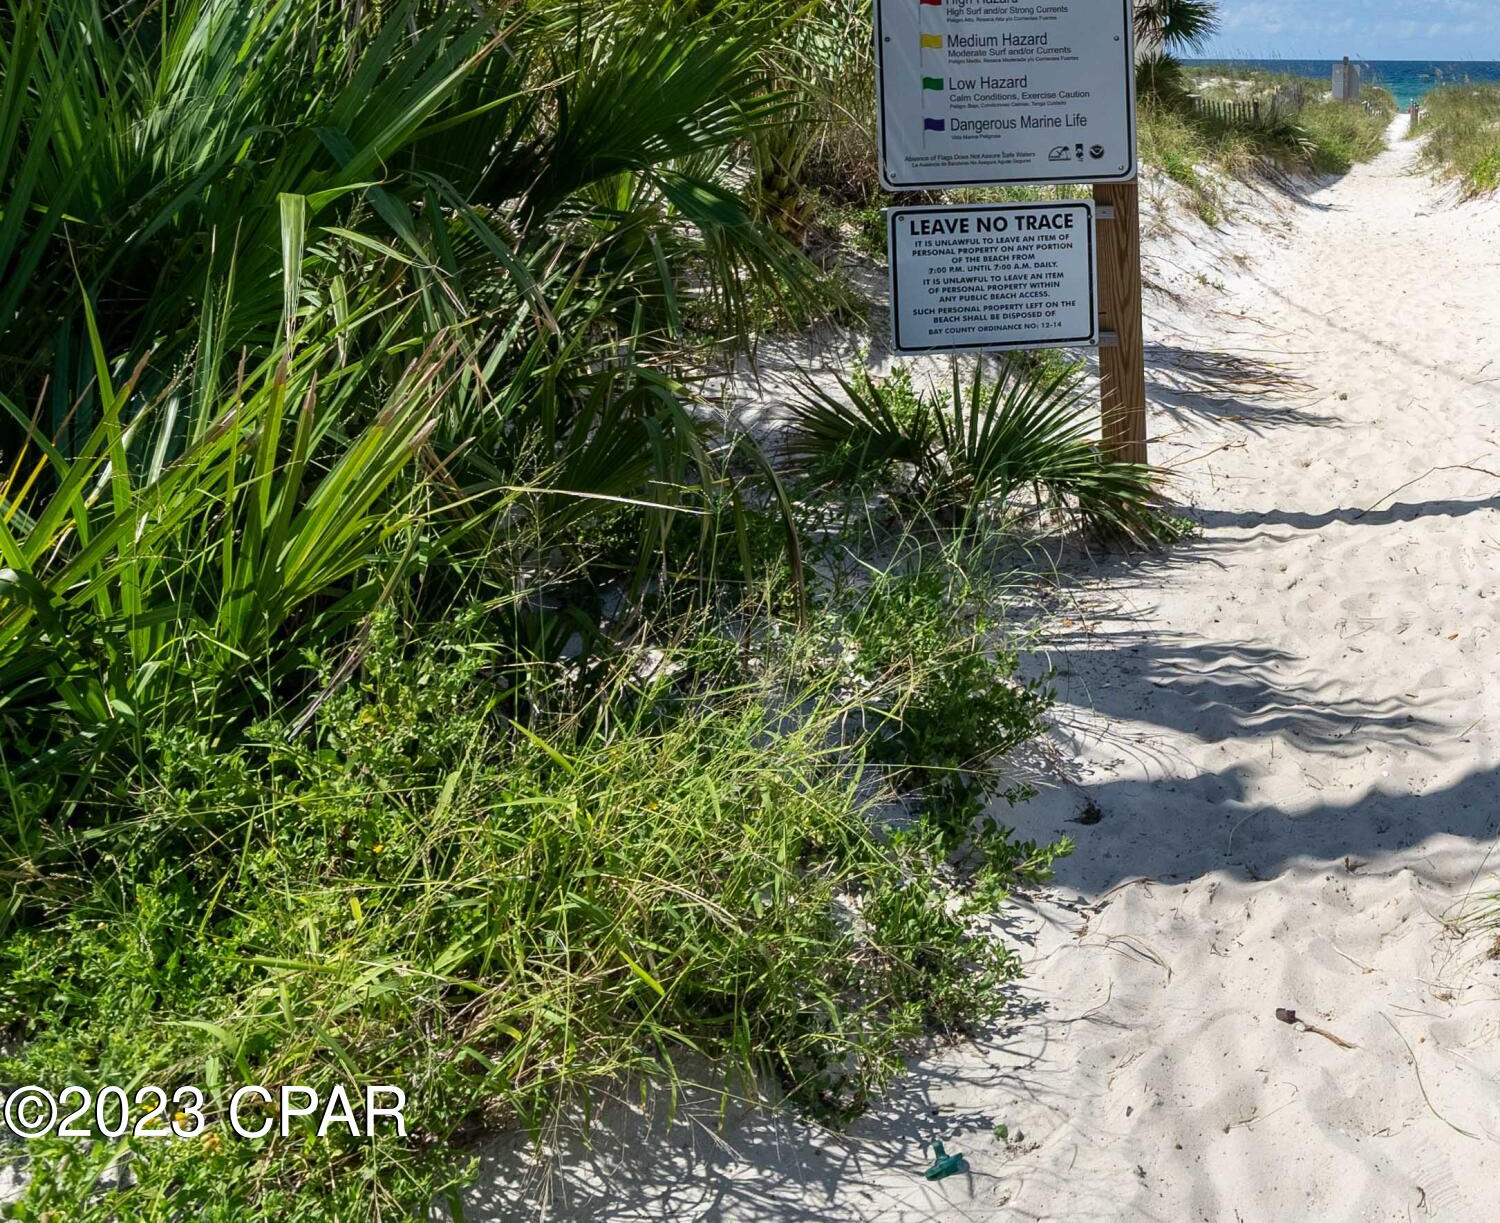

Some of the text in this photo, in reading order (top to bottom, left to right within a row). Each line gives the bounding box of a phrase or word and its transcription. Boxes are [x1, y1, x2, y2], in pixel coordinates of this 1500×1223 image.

[946, 5, 1069, 16] High Surf and/or Strong Currents
[947, 32, 1048, 48] Medium Hazard
[948, 46, 1072, 57] Moderate Surf and/or Currents
[949, 75, 1028, 91] Low Hazard
[949, 90, 1090, 102] Calm Conditions, Exercise Caution
[950, 114, 1088, 133] Dangerous Marine Life
[910, 213, 1074, 236] LEAVE NO TRACE
[915, 240, 922, 248] IT
[934, 238, 981, 247] UNLAWFUL
[982, 237, 994, 245] TO
[995, 236, 1020, 244] LEAVE
[1022, 235, 1035, 243] AN
[1037, 234, 1057, 242] ITEM
[1058, 233, 1070, 241] OF
[912, 242, 1073, 257] PERSONAL PROPERTY ON ANY PORTION
[951, 256, 963, 264] OF
[983, 255, 1010, 263] BEACH
[1011, 253, 1036, 261] FROM
[928, 266, 947, 275] 7:00
[967, 264, 992, 272] UNTIL
[993, 263, 1012, 271] 7:00
[1013, 262, 1032, 270] A.M.
[923, 278, 931, 286] IT
[943, 276, 989, 285] UNLAWFUL
[1003, 273, 1028, 282] LEAVE
[928, 281, 1060, 295] OF PERSONAL PROPERTY WITHIN
[939, 295, 957, 303] ANY
[959, 293, 988, 302] PUBLIC
[990, 292, 1017, 300] BEACH
[912, 308, 936, 316] SUCH
[937, 305, 981, 314] PERSONAL
[983, 303, 1024, 312] PROPERTY
[1025, 302, 1044, 310] LEFT
[1045, 301, 1059, 309] ON
[933, 310, 1056, 324] BEACH SHALL BE DISPOSED OF
[928, 328, 943, 336] BAY
[944, 326, 976, 334] COUNTY
[977, 323, 1022, 333] ORDINANCE
